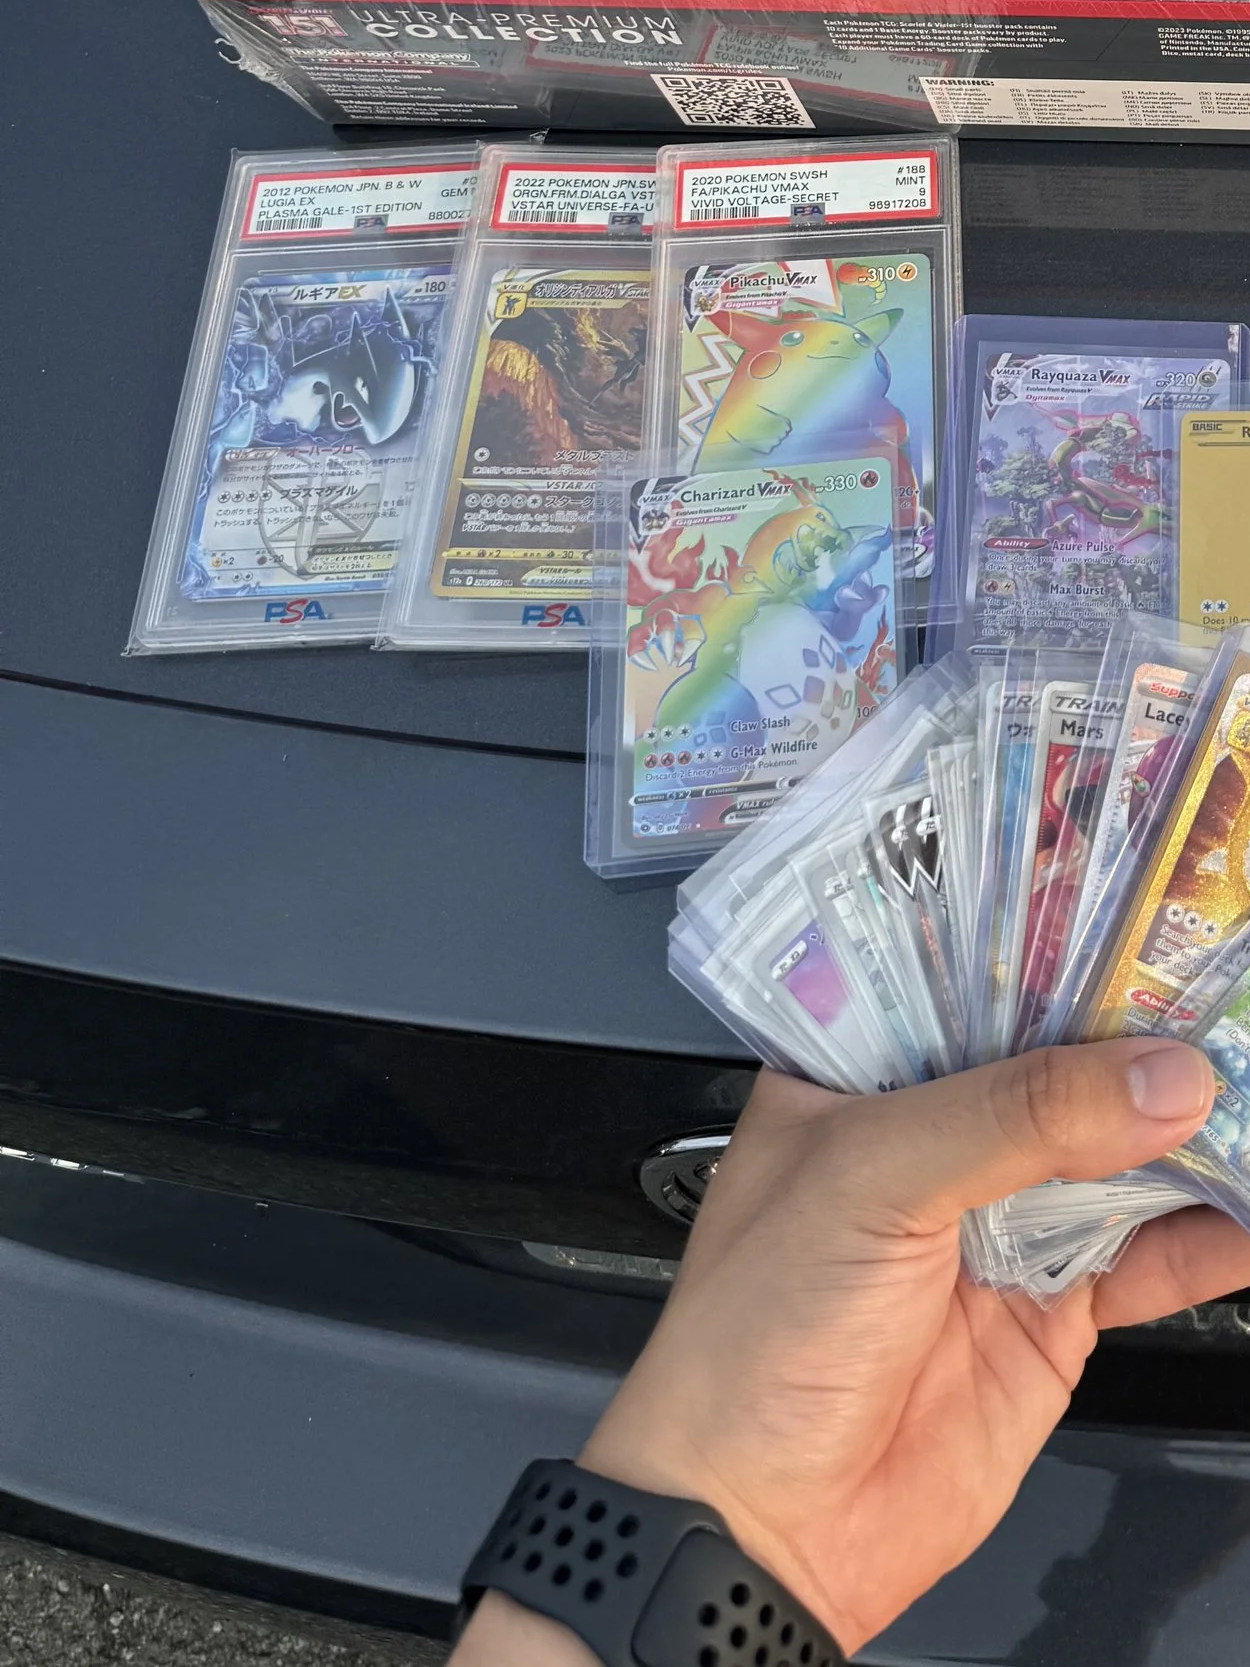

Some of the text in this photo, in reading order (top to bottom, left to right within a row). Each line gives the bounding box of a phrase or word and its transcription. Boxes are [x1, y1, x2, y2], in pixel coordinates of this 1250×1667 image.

[261, 14, 348, 37] 151
[350, 10, 676, 30] ULTRA-PREMIUM
[365, 23, 684, 46] COLLECTION
[515, 177, 546, 188] 2022
[548, 178, 611, 189] POKEMON
[692, 165, 926, 186] 2020 POKEMON SWSH #188
[262, 179, 422, 198] 2012 POKEMON JPN. B & W
[512, 189, 627, 201] ORGN.FRM.DIALGA
[691, 175, 926, 197] FA/PIKACHU VMAX MINT
[260, 188, 468, 209] LUGIA EX GEM
[511, 200, 554, 211] VSTAR
[691, 186, 927, 209] VIVID VOLTAGE-SECRET 9
[258, 202, 423, 220] PLASMA GALE-1ST EDITION
[793, 204, 824, 218] PSA
[730, 271, 819, 291] Pikachu VMAX
[867, 266, 896, 282] 310
[1032, 368, 1132, 385] Rayquaza VMAX
[1167, 372, 1197, 385] 320
[1192, 422, 1223, 431] BASIC
[680, 482, 794, 504] Charizard VMAX
[823, 475, 858, 492] 330
[1050, 584, 1105, 596] Max Burst
[264, 598, 327, 625] PSA
[522, 603, 586, 629] PSA
[731, 717, 792, 733] Claw Slash
[1060, 718, 1104, 740] Mars
[731, 739, 819, 760] G-Max Wildfire
